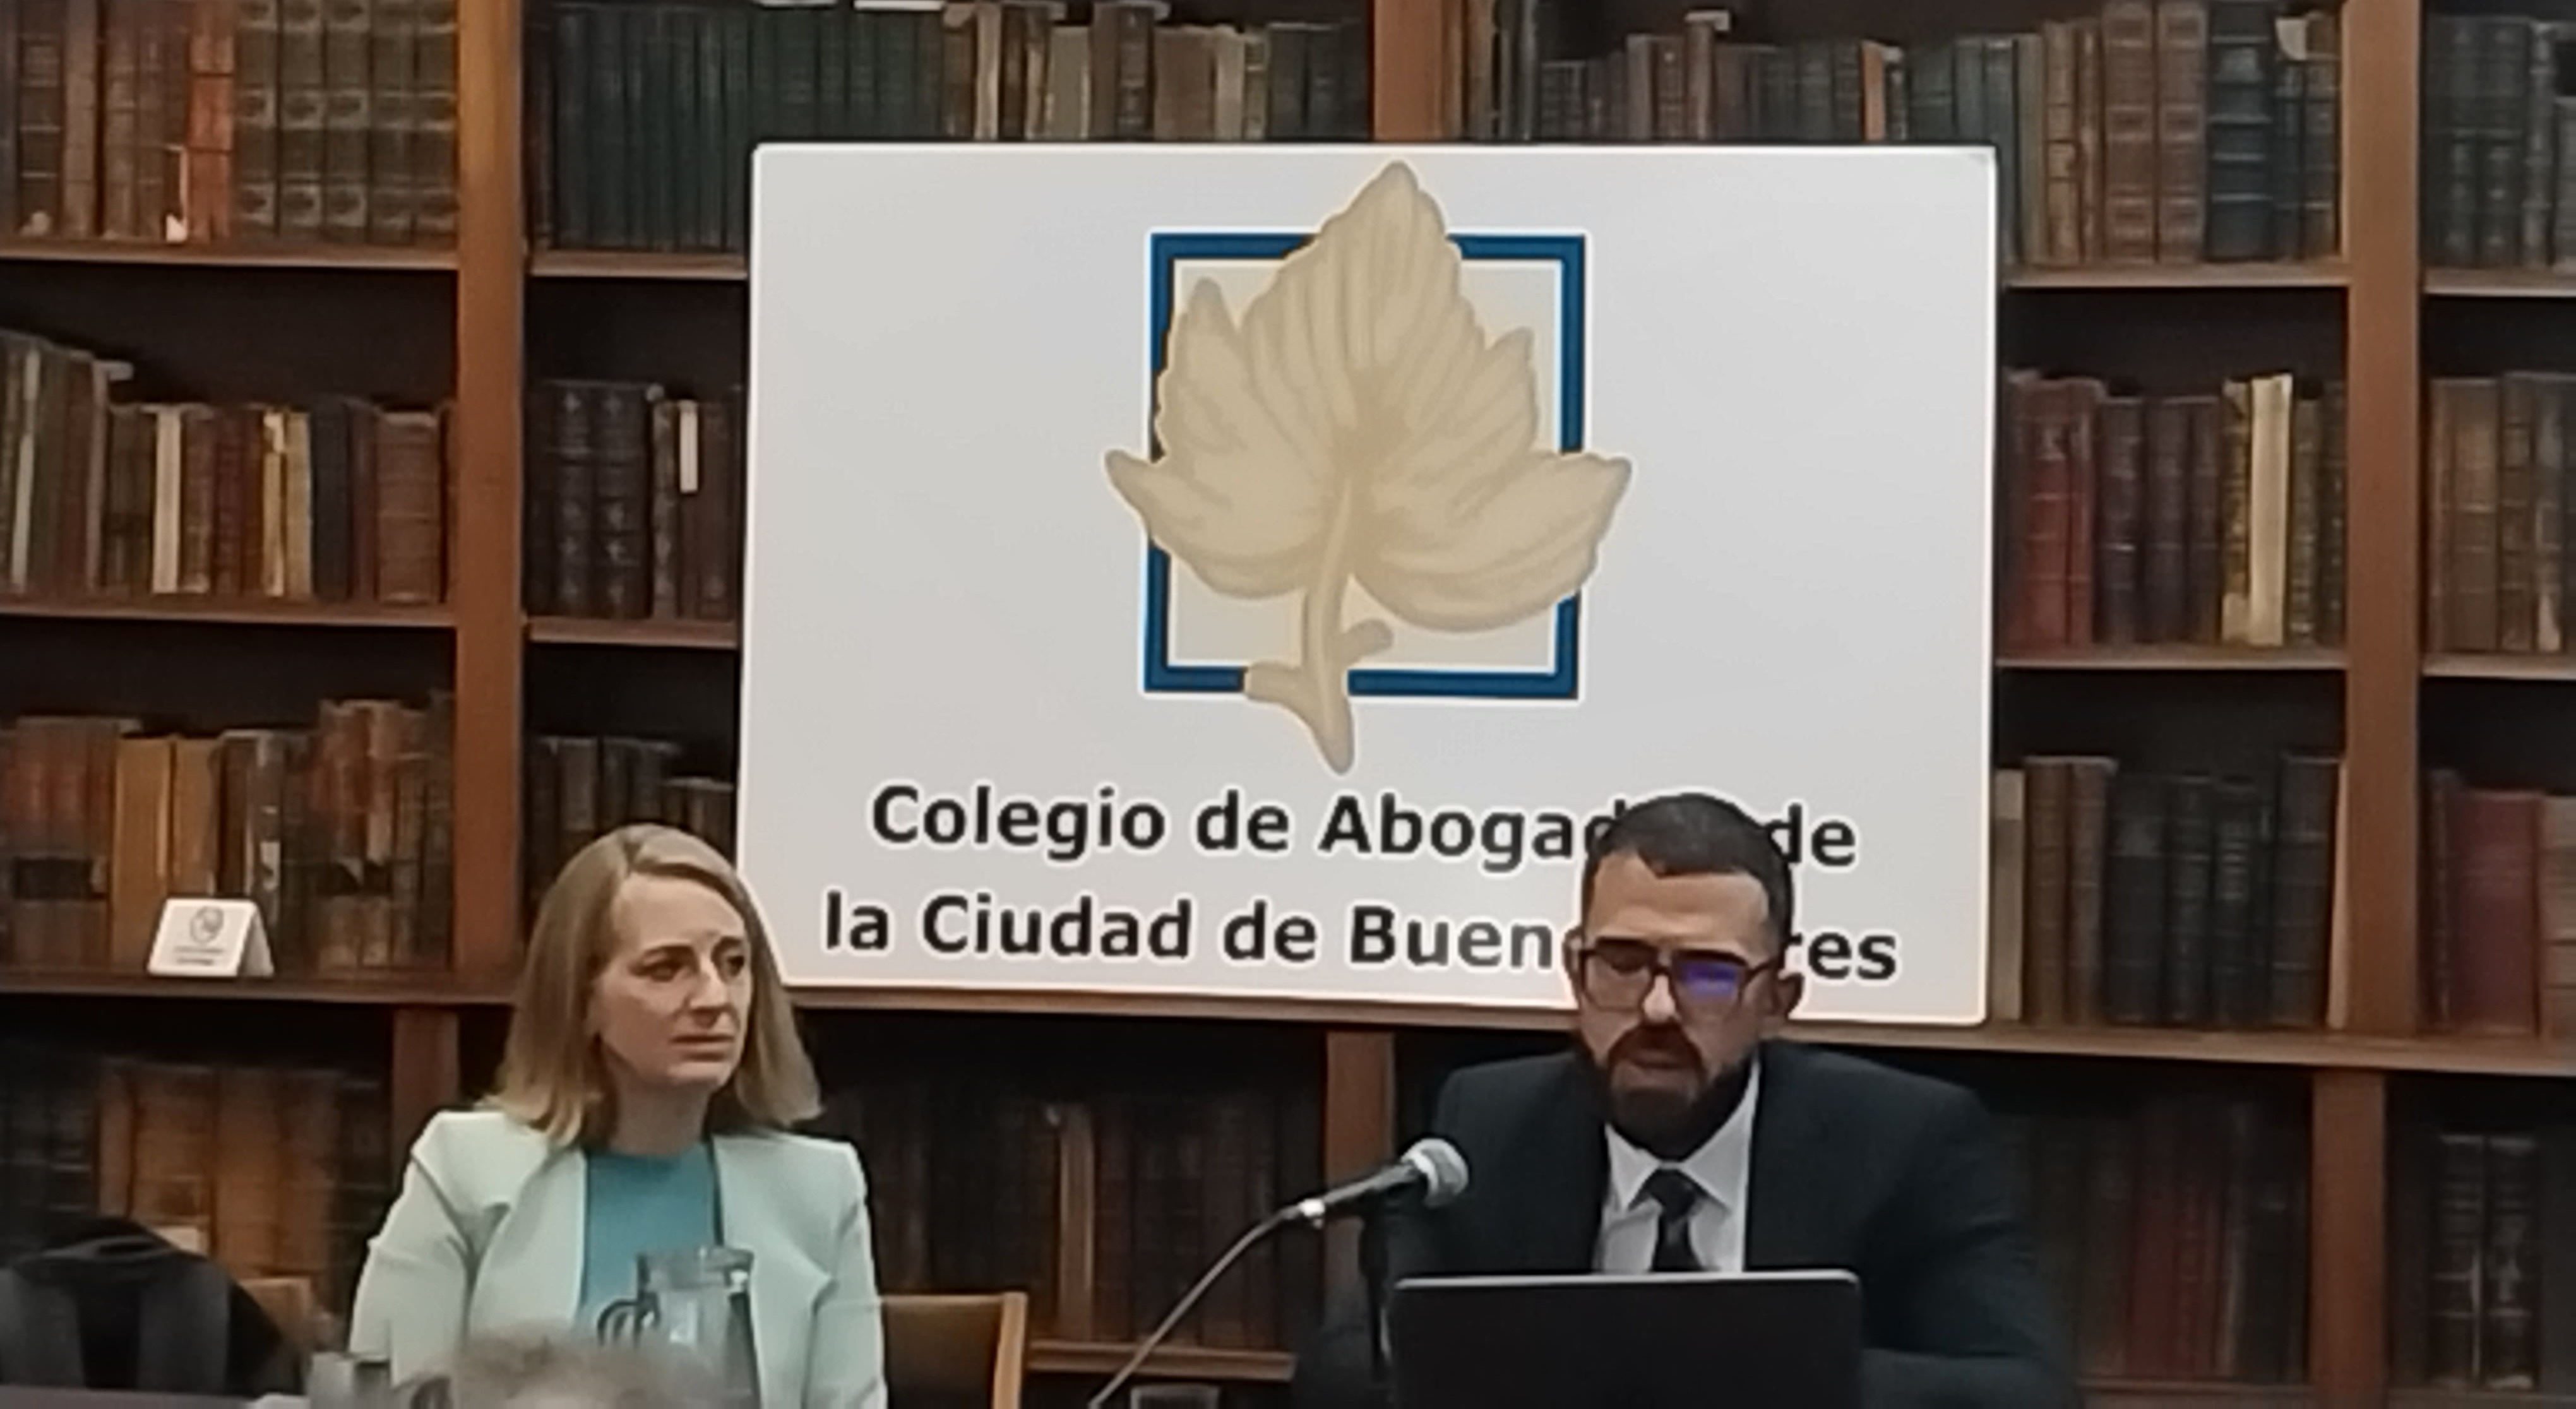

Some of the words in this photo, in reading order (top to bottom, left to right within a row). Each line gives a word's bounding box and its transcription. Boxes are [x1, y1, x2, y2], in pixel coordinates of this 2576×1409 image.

[873, 785, 1165, 861] Colegio
[1196, 790, 1289, 852] de
[1318, 793, 1625, 872] Abogad
[1767, 802, 1856, 867] de
[826, 891, 888, 950] la
[923, 893, 1191, 958] Ciudad
[1224, 900, 1316, 962] de
[1351, 906, 1553, 968] Buen
